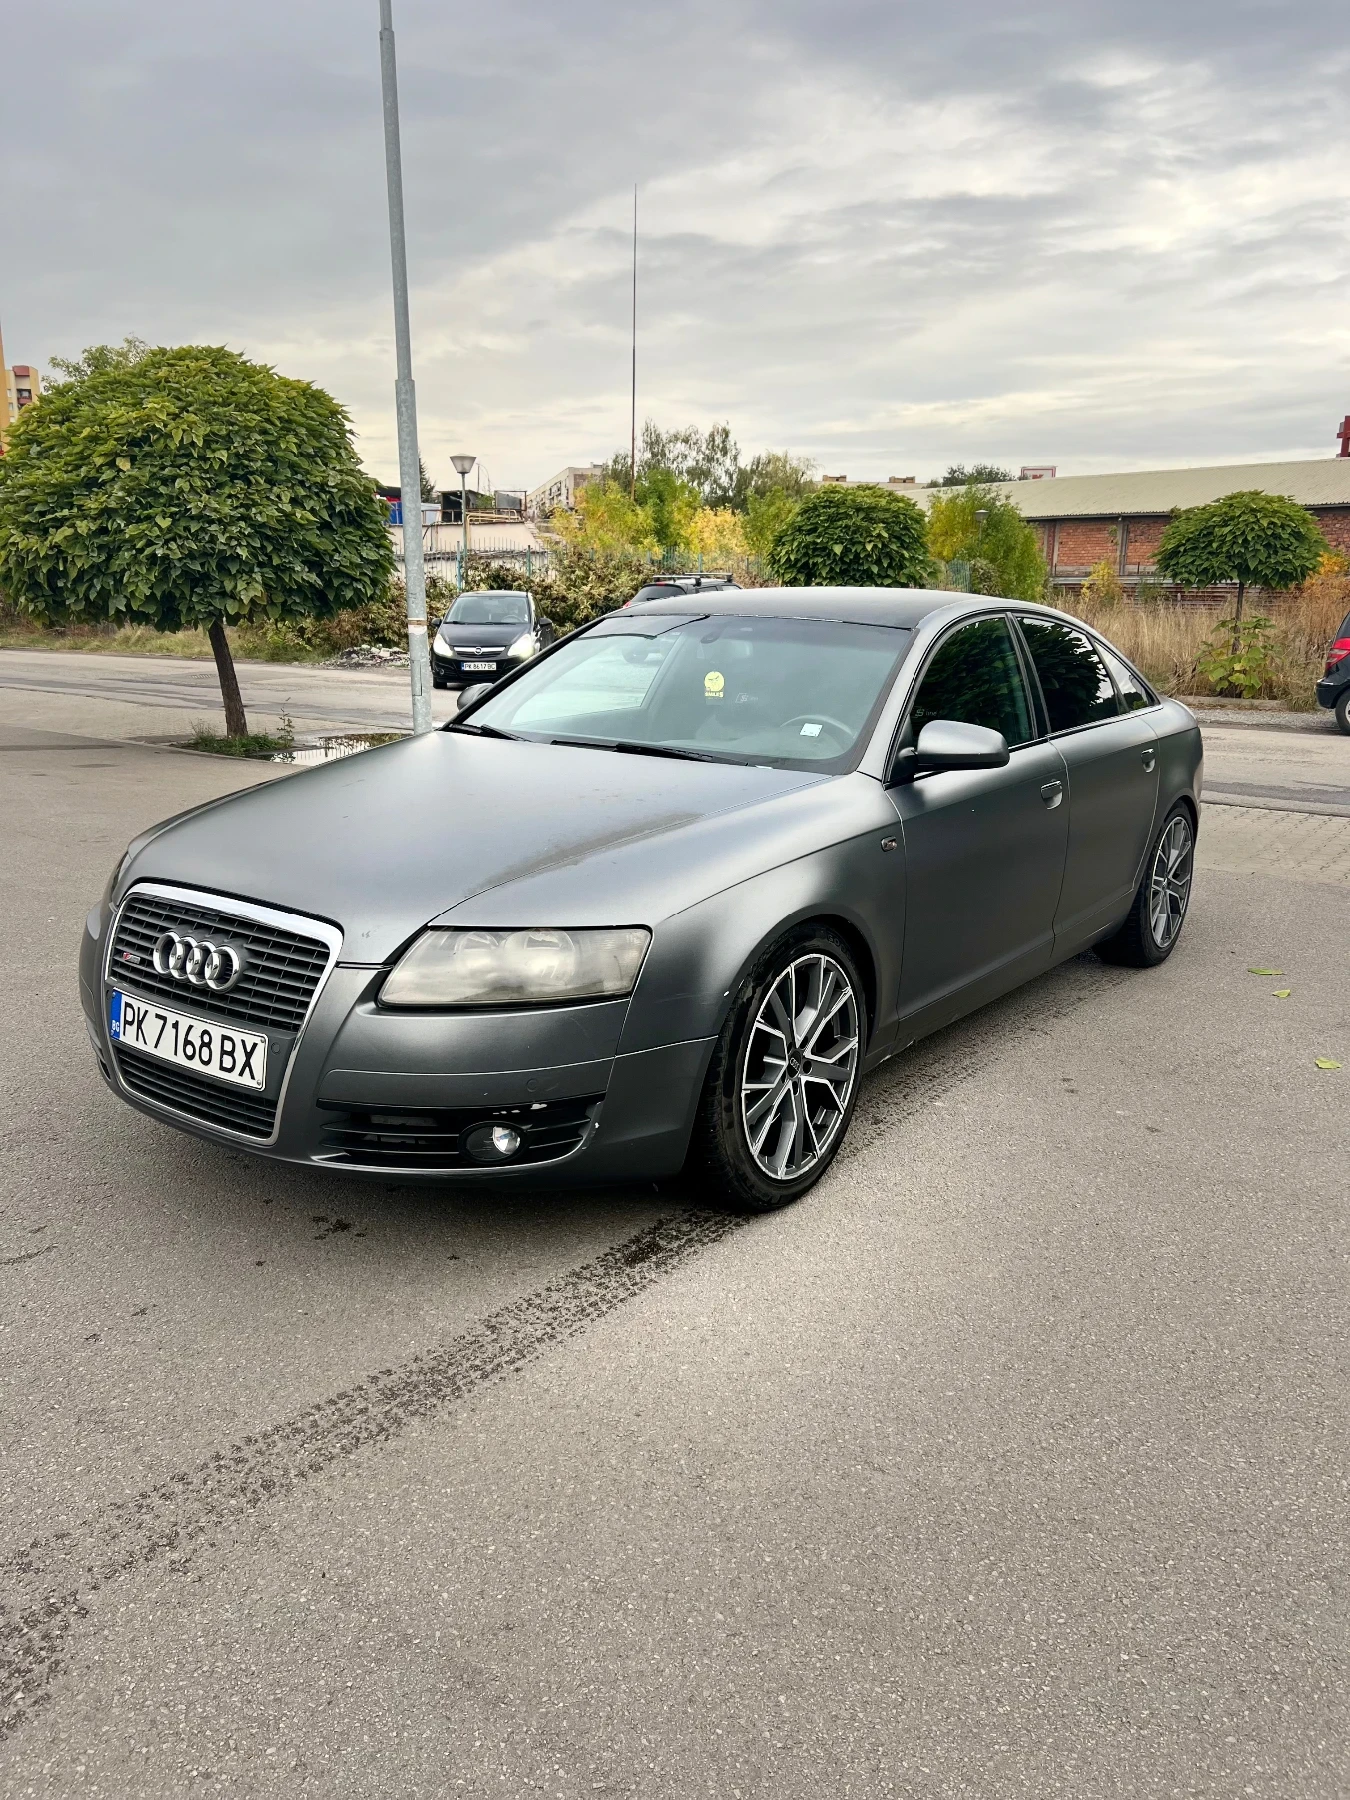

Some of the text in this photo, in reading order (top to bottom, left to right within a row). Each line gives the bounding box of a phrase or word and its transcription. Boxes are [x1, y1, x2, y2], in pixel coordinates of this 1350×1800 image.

[111, 1019, 120, 1032] BG
[123, 1001, 258, 1080] PK 7168 BX
